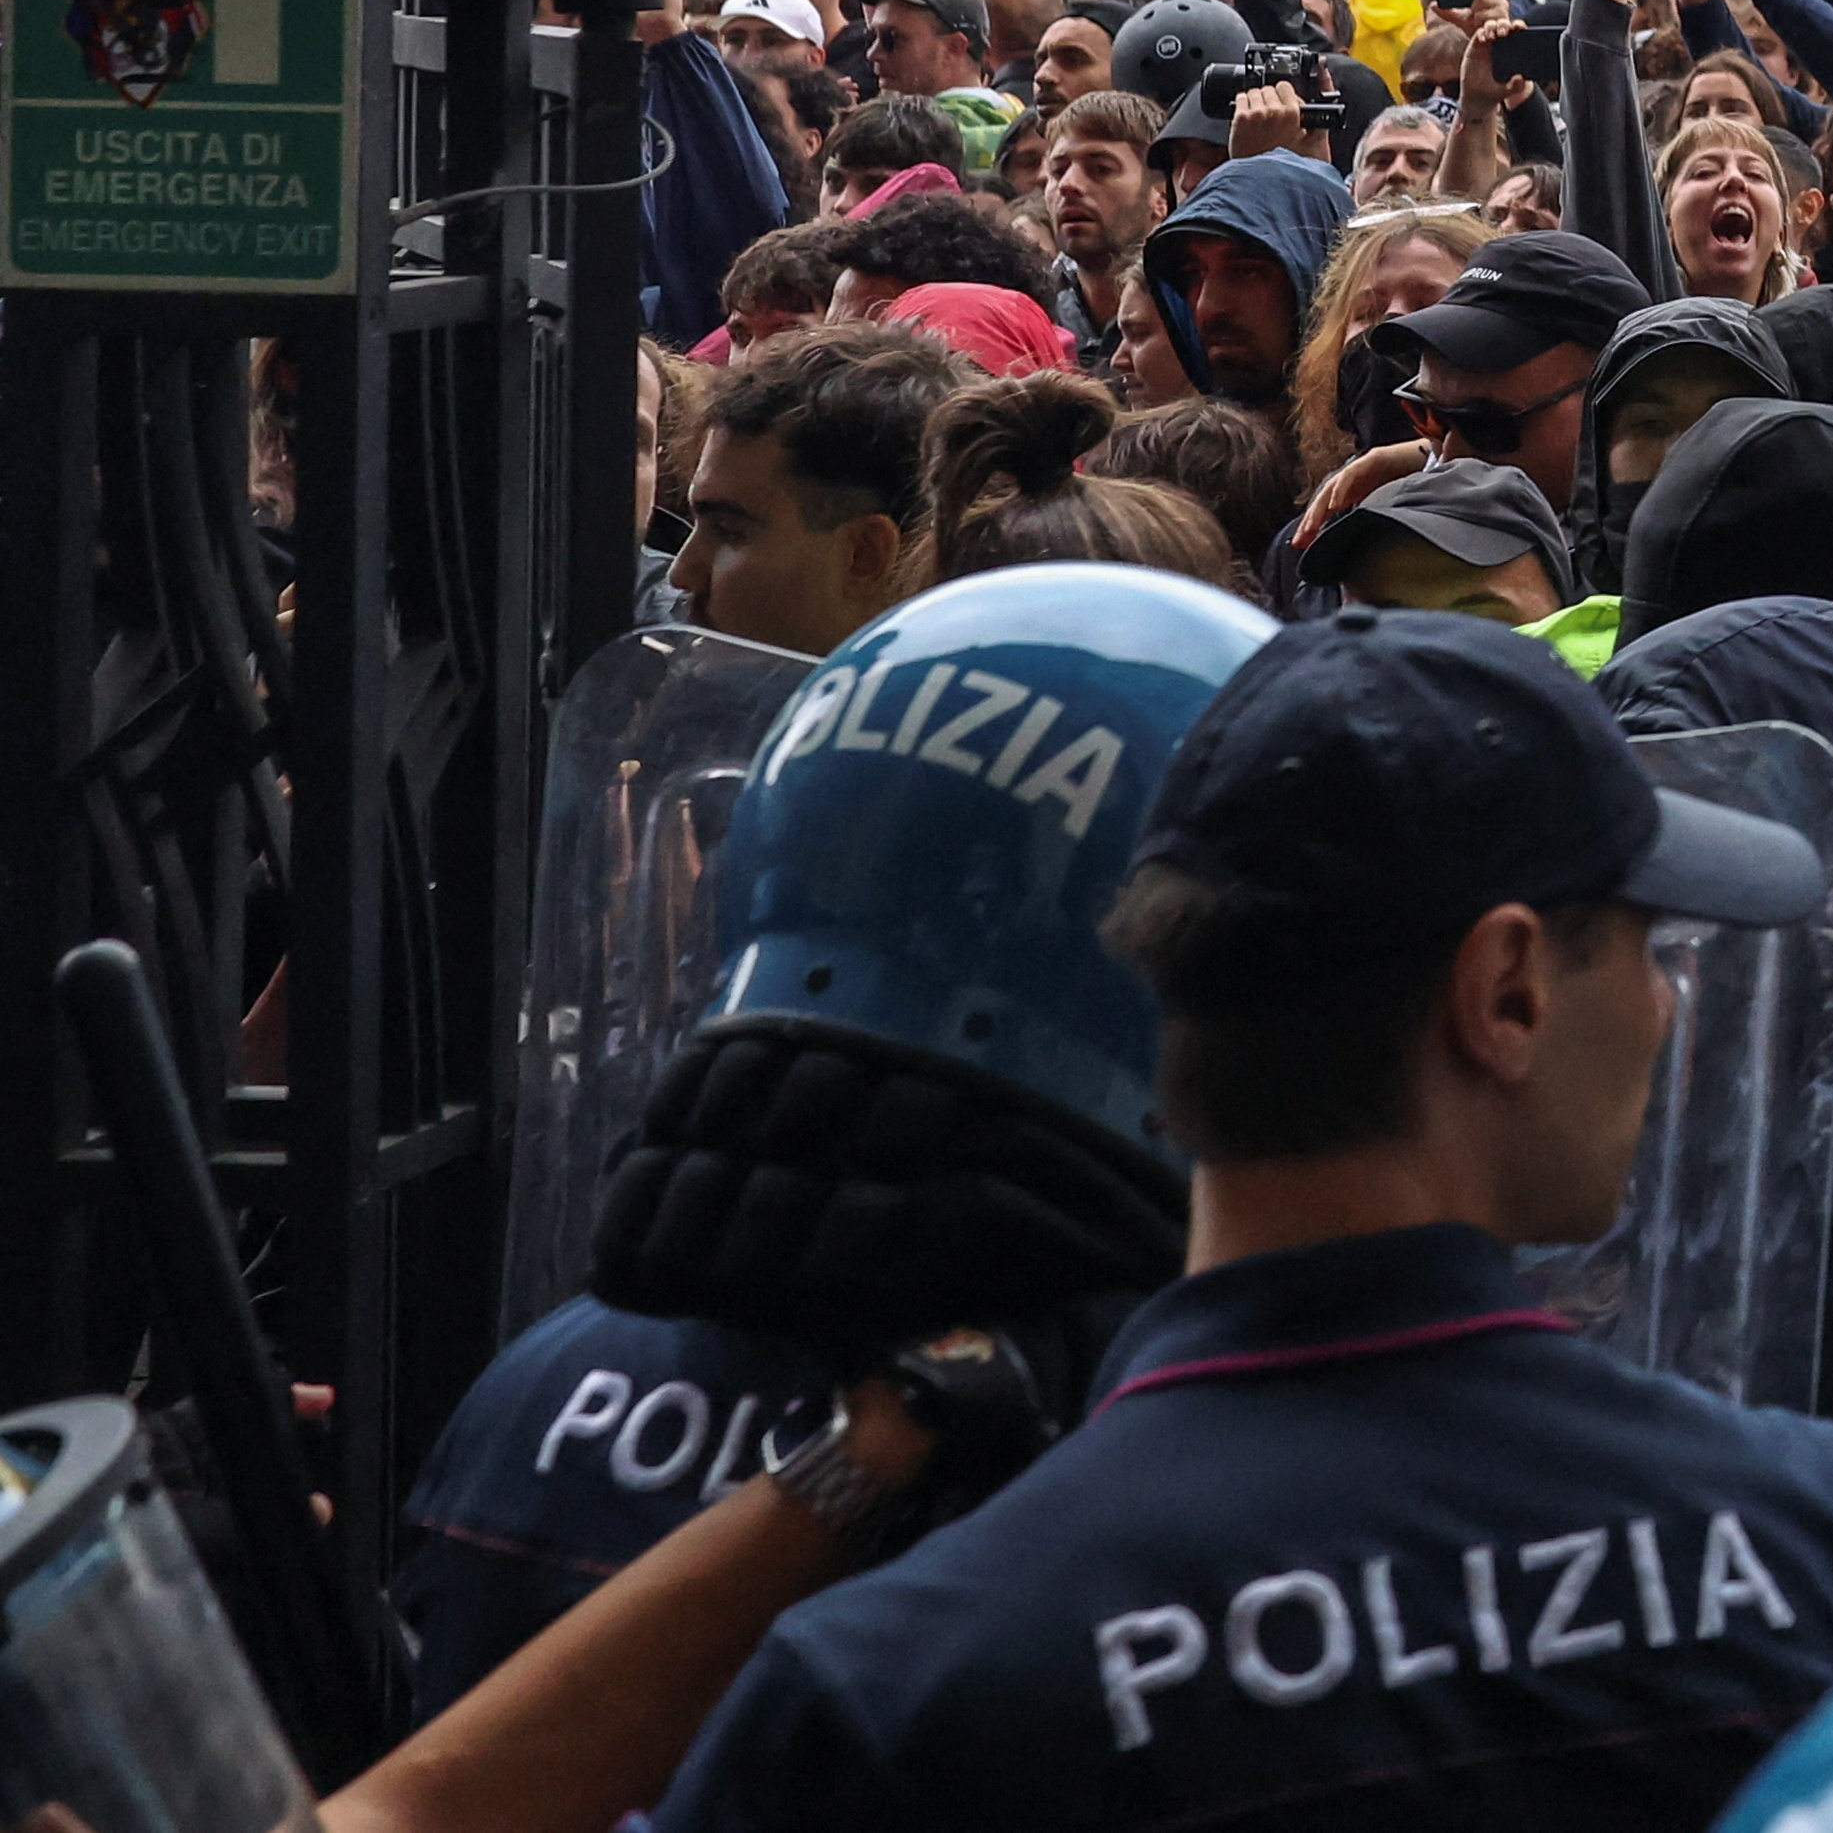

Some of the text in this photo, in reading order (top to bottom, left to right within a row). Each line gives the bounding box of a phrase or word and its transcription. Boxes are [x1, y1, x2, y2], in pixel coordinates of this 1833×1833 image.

[76, 131, 282, 164] USCITA DI
[48, 171, 308, 207] EMERGENZA
[20, 220, 333, 256] EMERGENCY EXIT
[1093, 1509, 1797, 1751] POLIZIA
